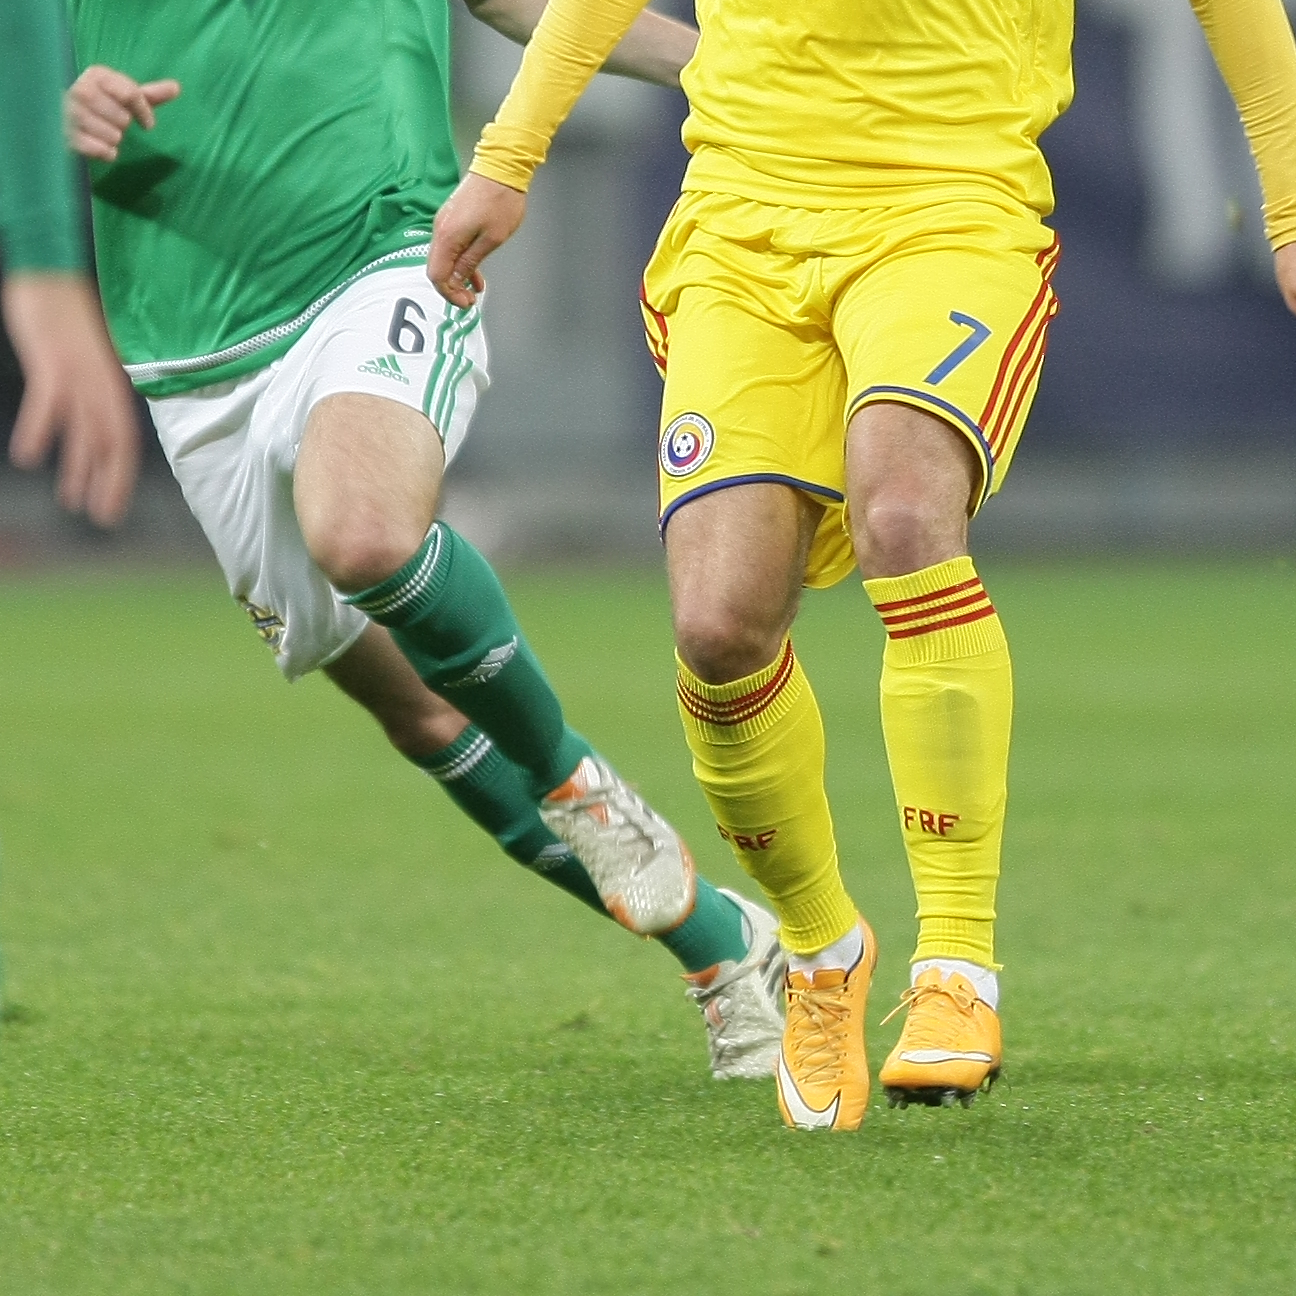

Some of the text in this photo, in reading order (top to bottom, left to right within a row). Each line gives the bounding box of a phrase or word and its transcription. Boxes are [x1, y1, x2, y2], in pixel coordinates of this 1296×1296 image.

[388, 296, 428, 353] 6
[923, 310, 992, 385] 7
[356, 363, 410, 386] adidas
[903, 806, 960, 836] FRF
